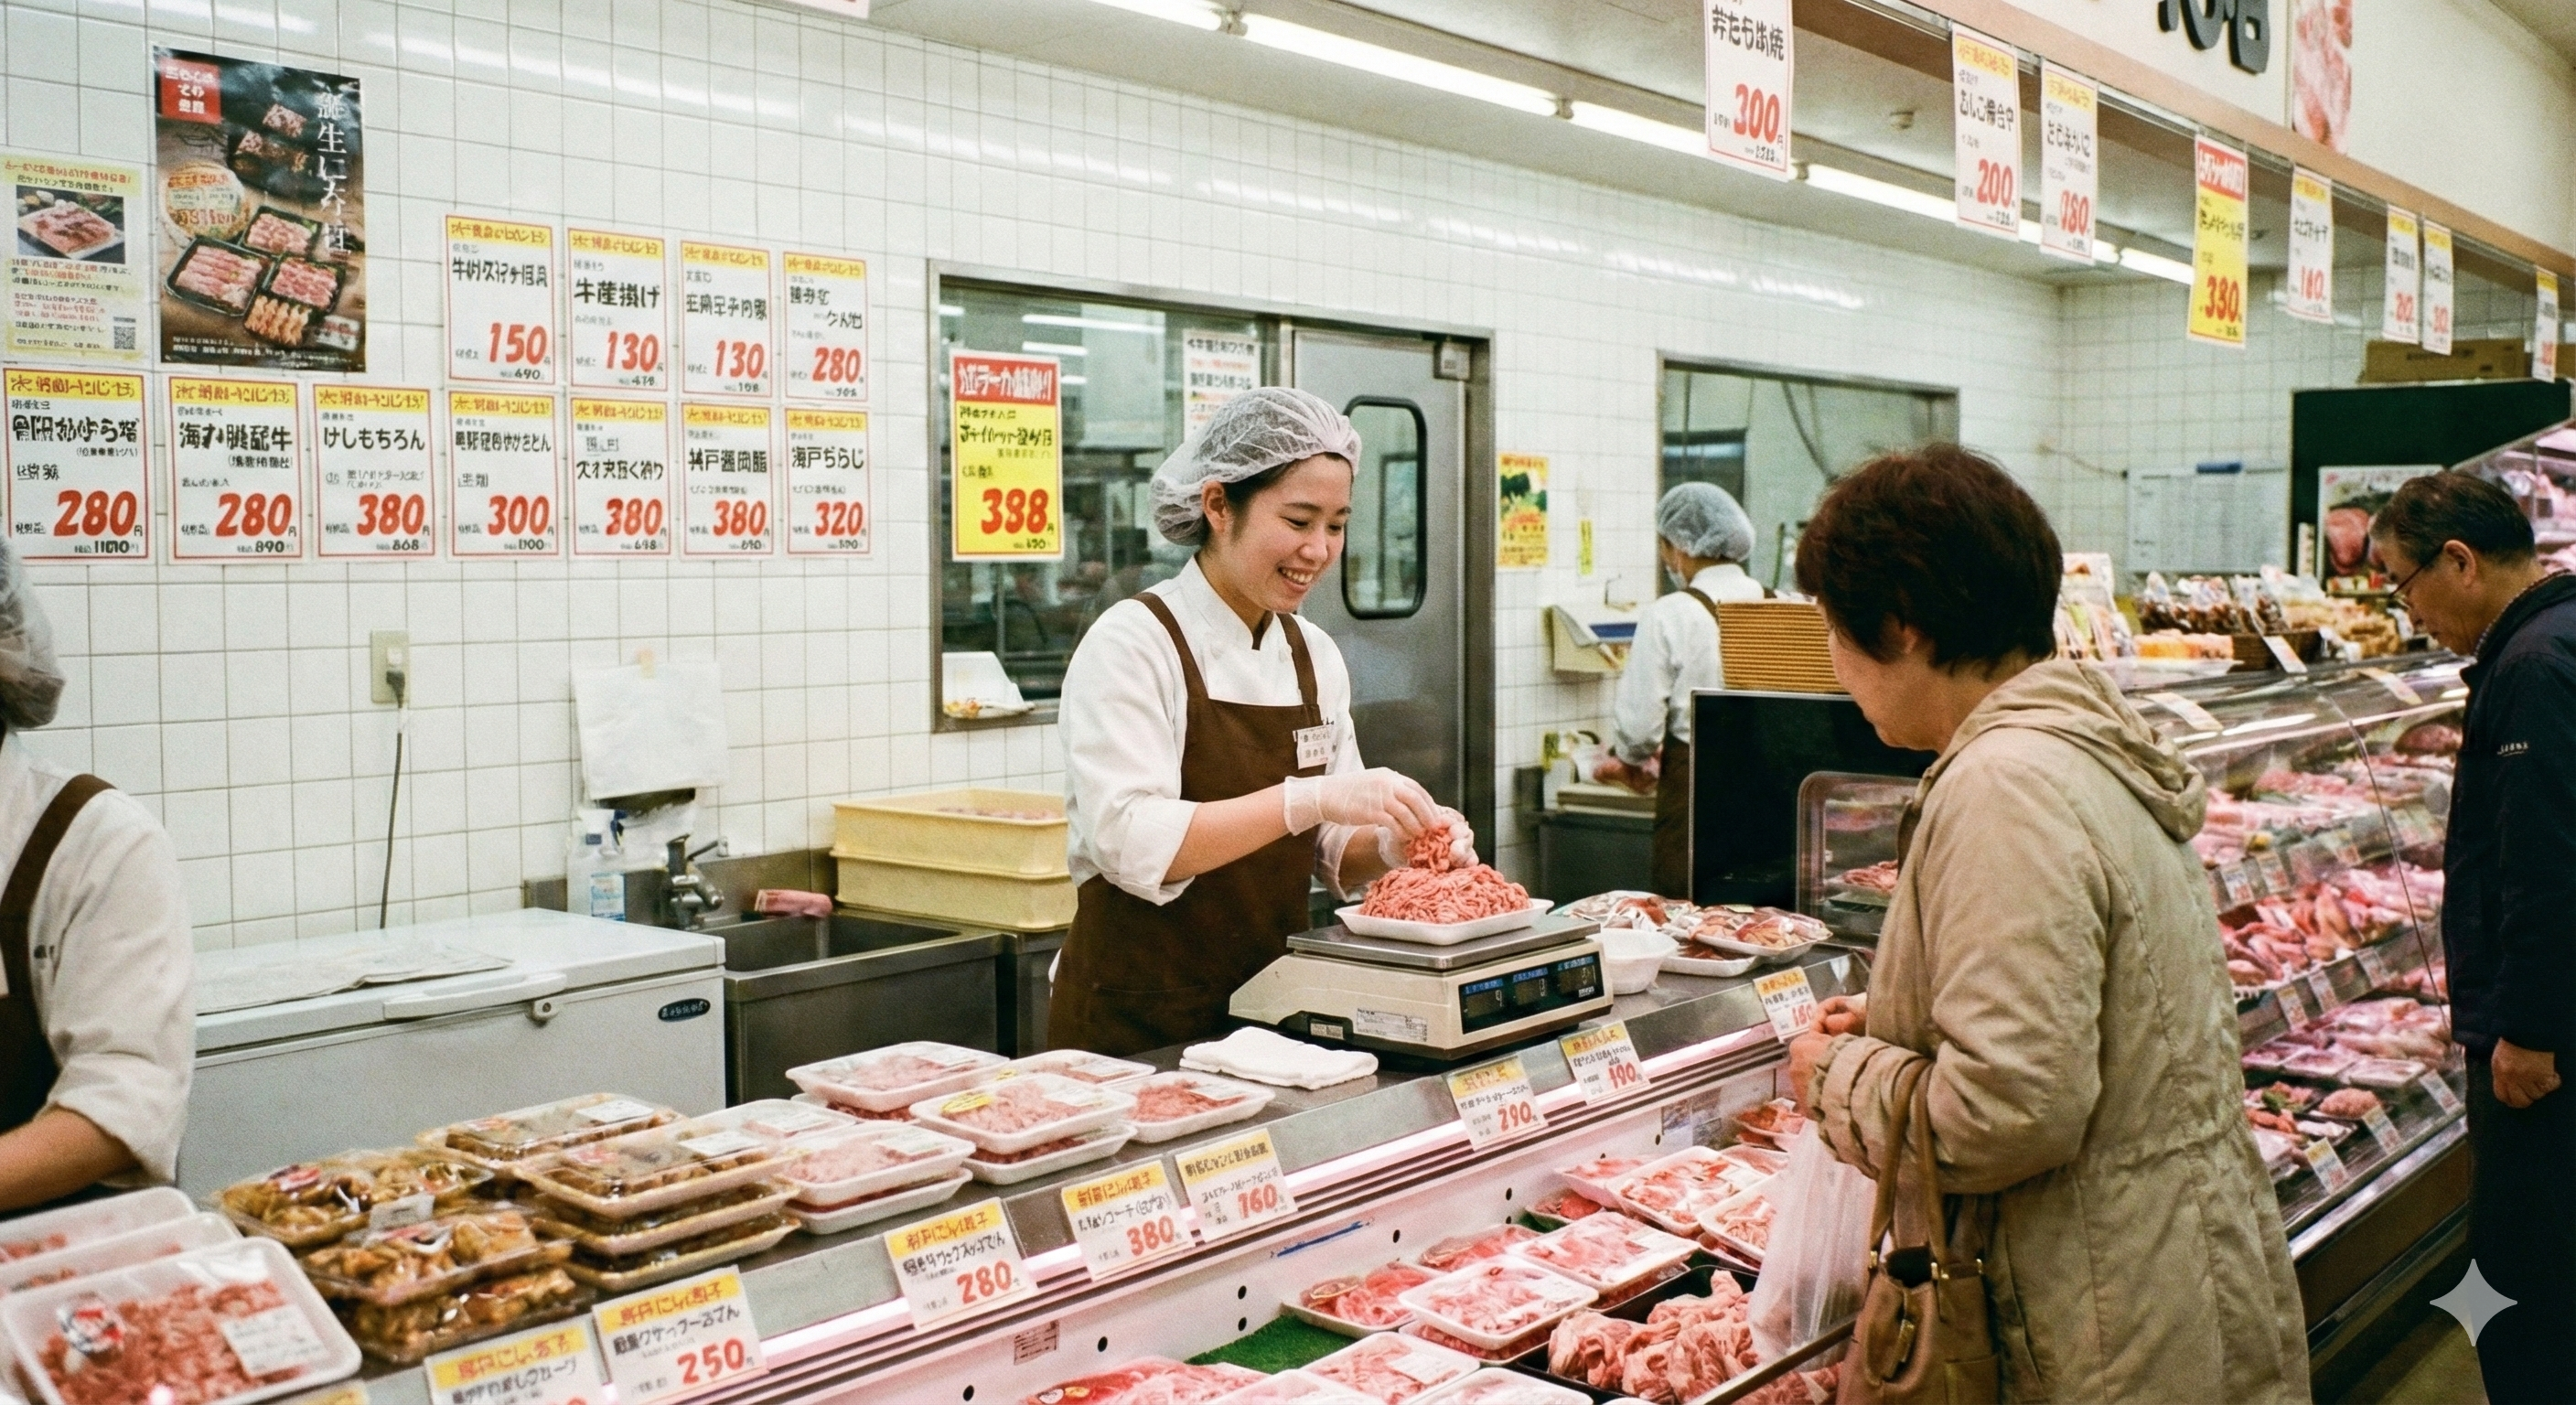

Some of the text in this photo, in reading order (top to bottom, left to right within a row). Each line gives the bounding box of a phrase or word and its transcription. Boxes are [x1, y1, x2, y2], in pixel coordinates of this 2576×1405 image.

[324, 427, 426, 451] けしもちろん
